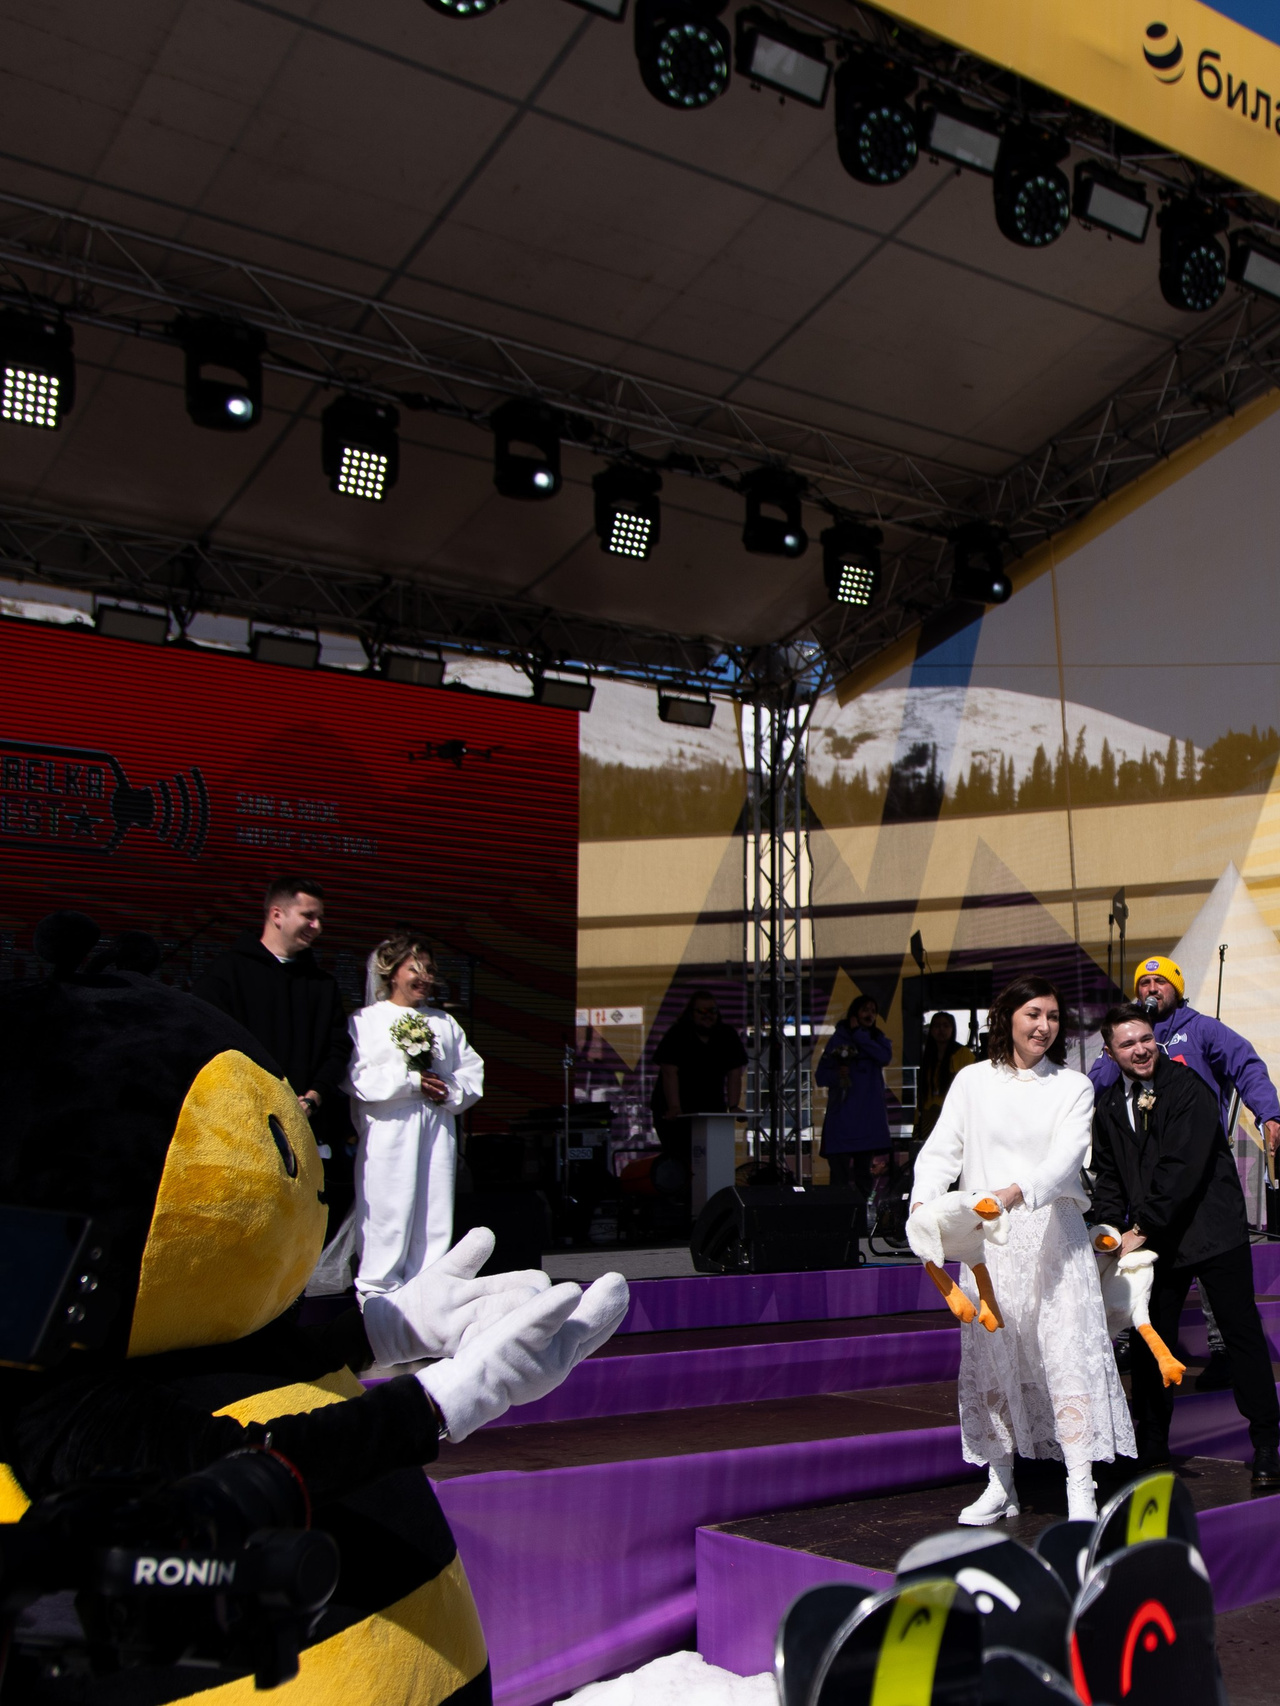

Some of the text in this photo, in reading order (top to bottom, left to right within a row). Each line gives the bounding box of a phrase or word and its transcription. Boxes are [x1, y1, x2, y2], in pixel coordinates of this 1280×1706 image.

[0, 756, 106, 799] RELKA
[0, 795, 66, 836] EST
[132, 1555, 237, 1587] RONIN
